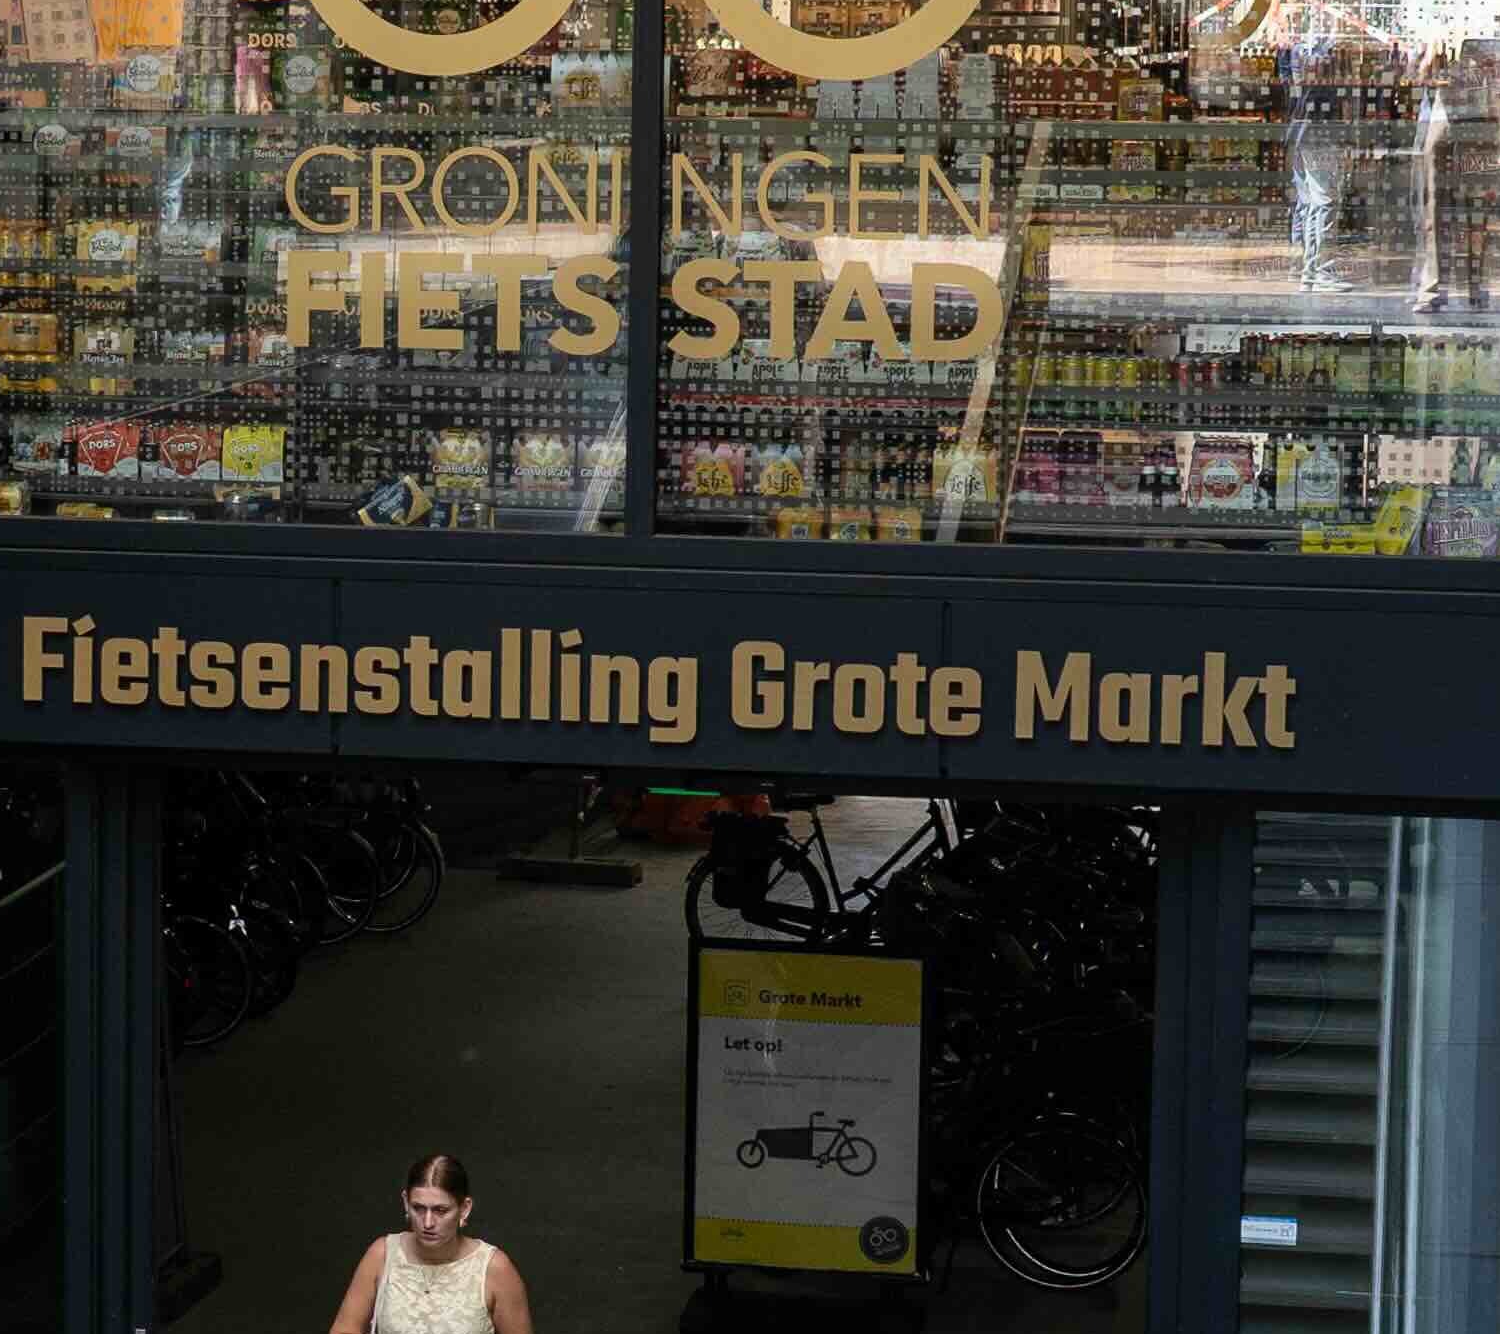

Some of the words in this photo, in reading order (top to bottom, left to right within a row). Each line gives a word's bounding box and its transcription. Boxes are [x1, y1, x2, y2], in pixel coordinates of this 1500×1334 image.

[21, 616, 700, 743] Fietsenstalling
[729, 639, 983, 737] Grote
[1013, 650, 1296, 749] Markt
[758, 989, 807, 1007] Grote
[810, 992, 864, 1009] Markt
[723, 1036, 750, 1051] Let
[753, 1038, 783, 1054] op!
